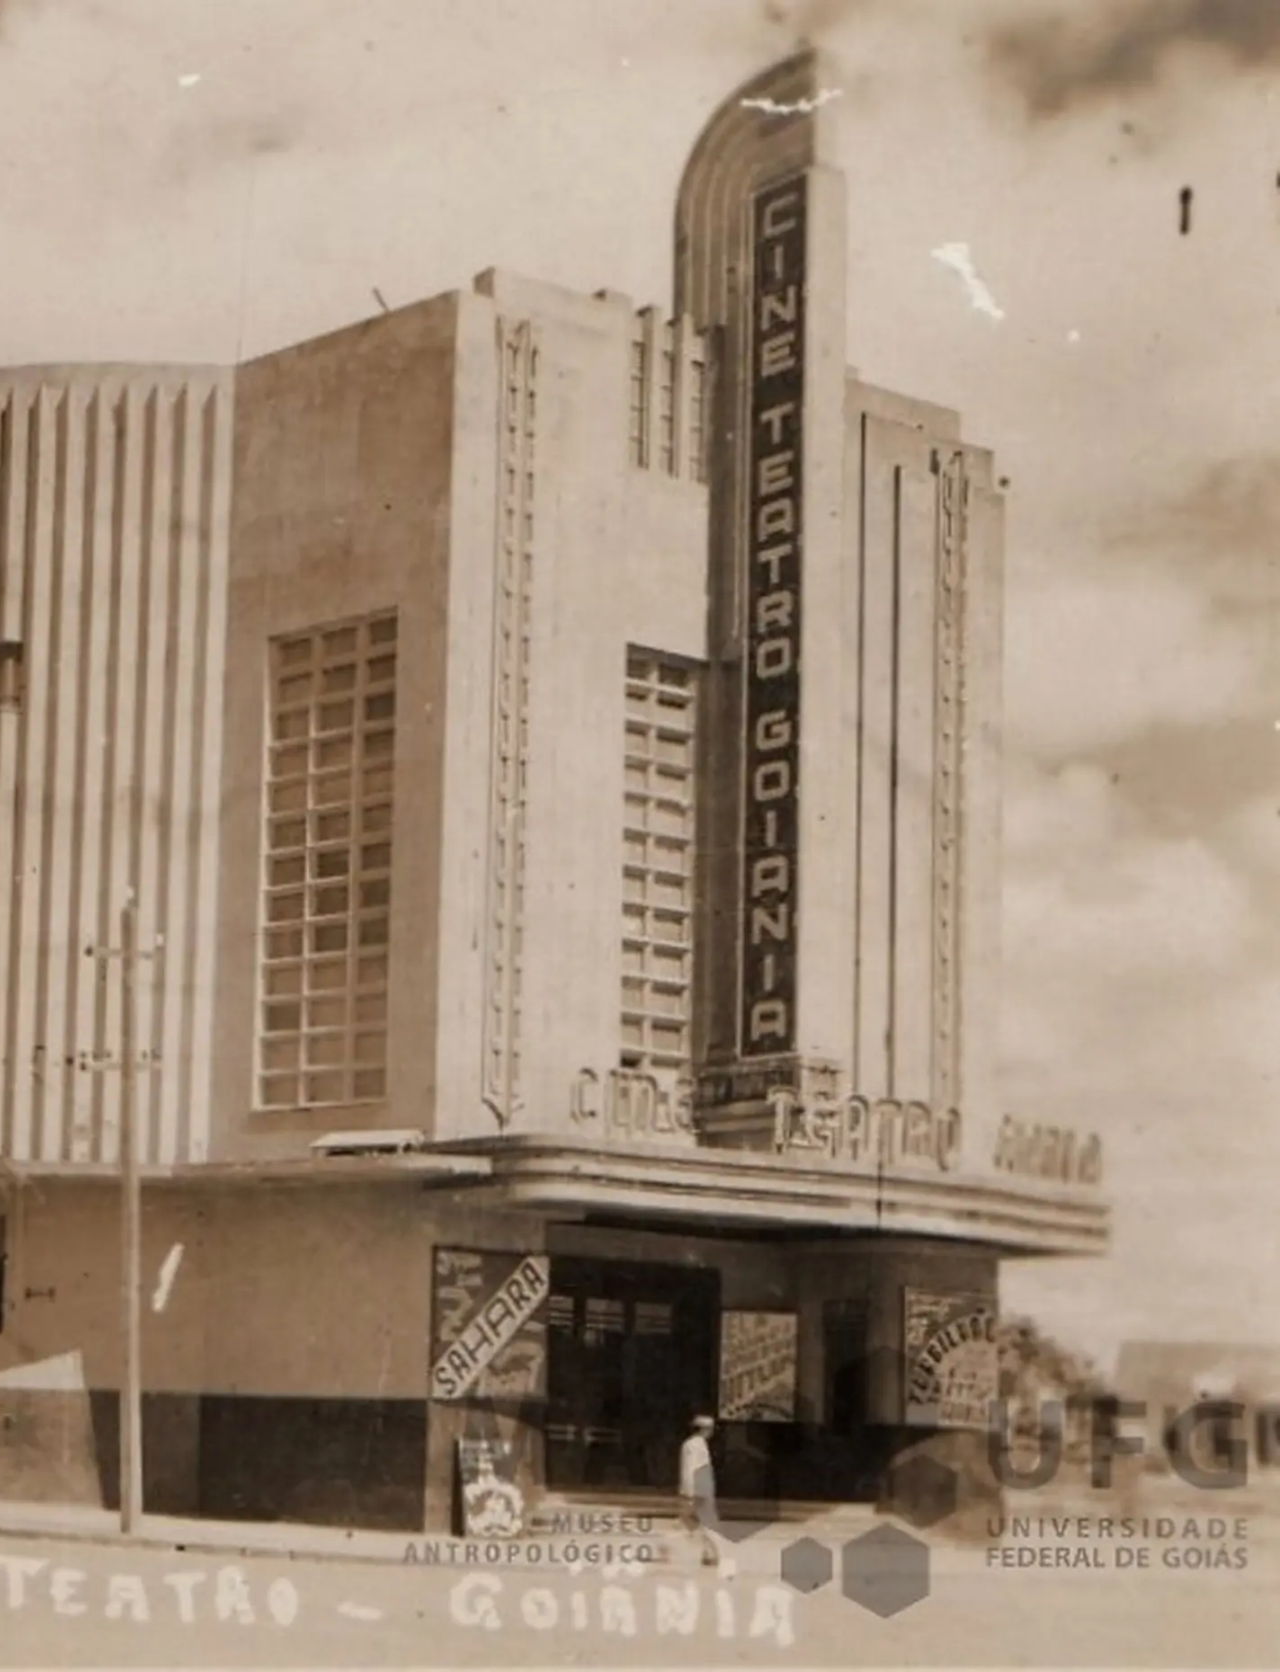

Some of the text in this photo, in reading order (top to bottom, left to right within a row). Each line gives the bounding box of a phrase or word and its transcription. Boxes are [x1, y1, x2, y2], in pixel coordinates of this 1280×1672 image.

[751, 193, 800, 1041] CINE TEATRO GOIANIA
[434, 1261, 547, 1396] SAHARA
